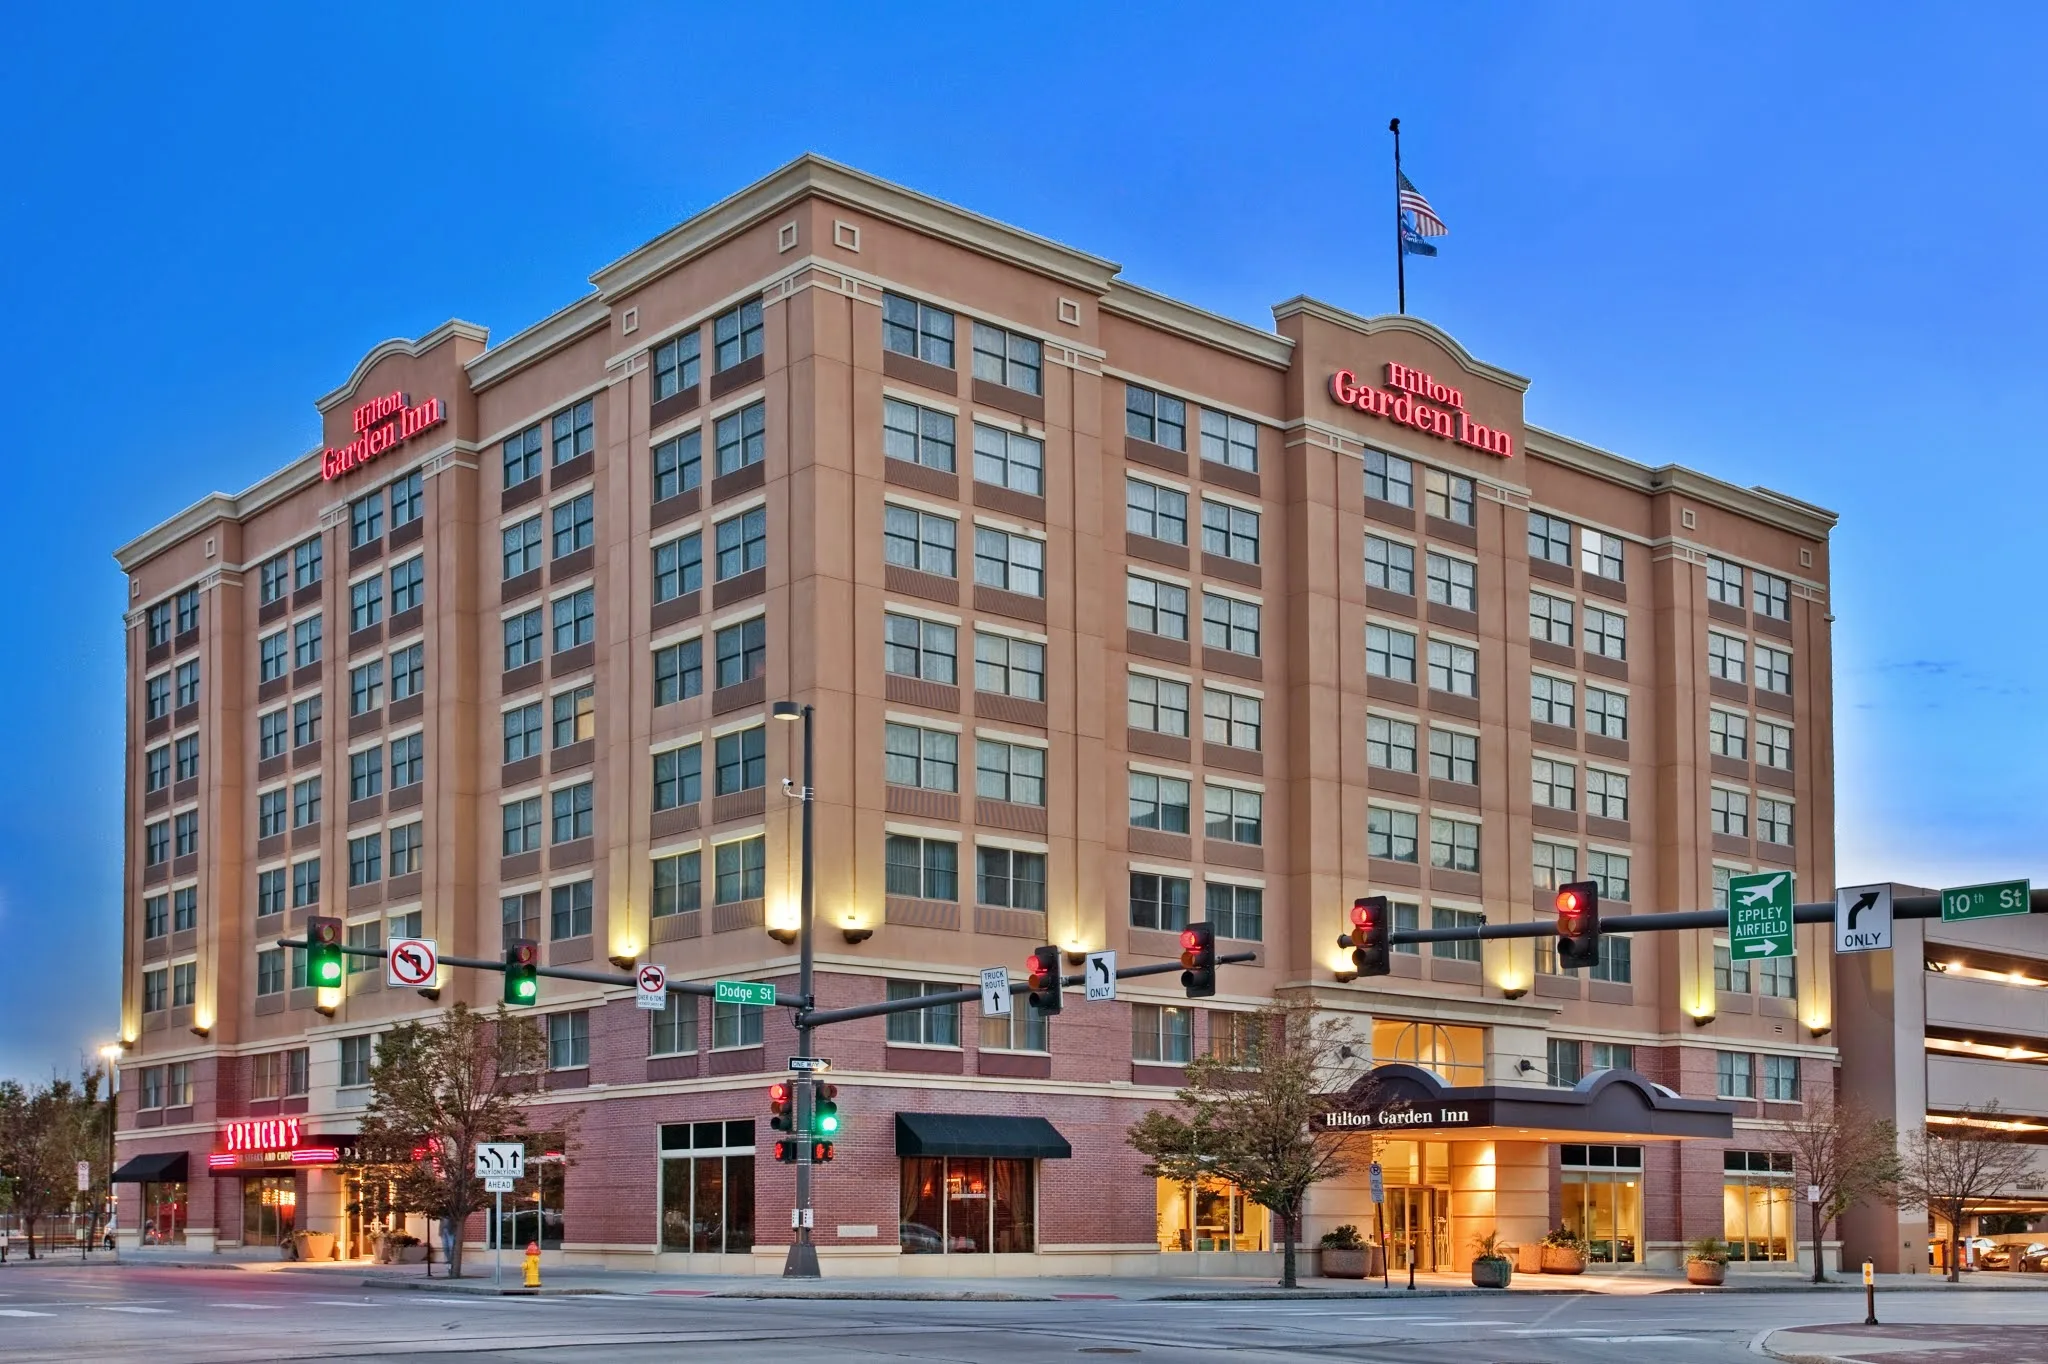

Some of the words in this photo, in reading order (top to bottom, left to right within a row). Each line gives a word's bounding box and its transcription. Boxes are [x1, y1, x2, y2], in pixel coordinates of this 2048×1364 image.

[1388, 361, 1463, 409] Hilton
[353, 391, 403, 433] Hilton
[1333, 369, 1453, 438] Garden
[1459, 410, 1513, 458] Inn
[321, 422, 396, 480] Garden
[400, 398, 440, 440] Inn
[1948, 893, 1985, 914] 10th
[2000, 888, 2023, 909] St
[1738, 906, 1783, 922] EPPLEY
[1735, 920, 1787, 936] AIRFIELD
[1844, 932, 1882, 947] ONLY
[984, 971, 1004, 979] TRUCK
[719, 985, 752, 1001] Dodge
[760, 988, 771, 1000] St
[985, 981, 1005, 989] ROUTE
[1090, 987, 1110, 998] ONLY
[1326, 1111, 1371, 1126] Hilton
[1378, 1109, 1432, 1125] Garden
[1440, 1108, 1469, 1122] Inn
[227, 1118, 298, 1150] SPENCER'S
[264, 1152, 276, 1161] AND
